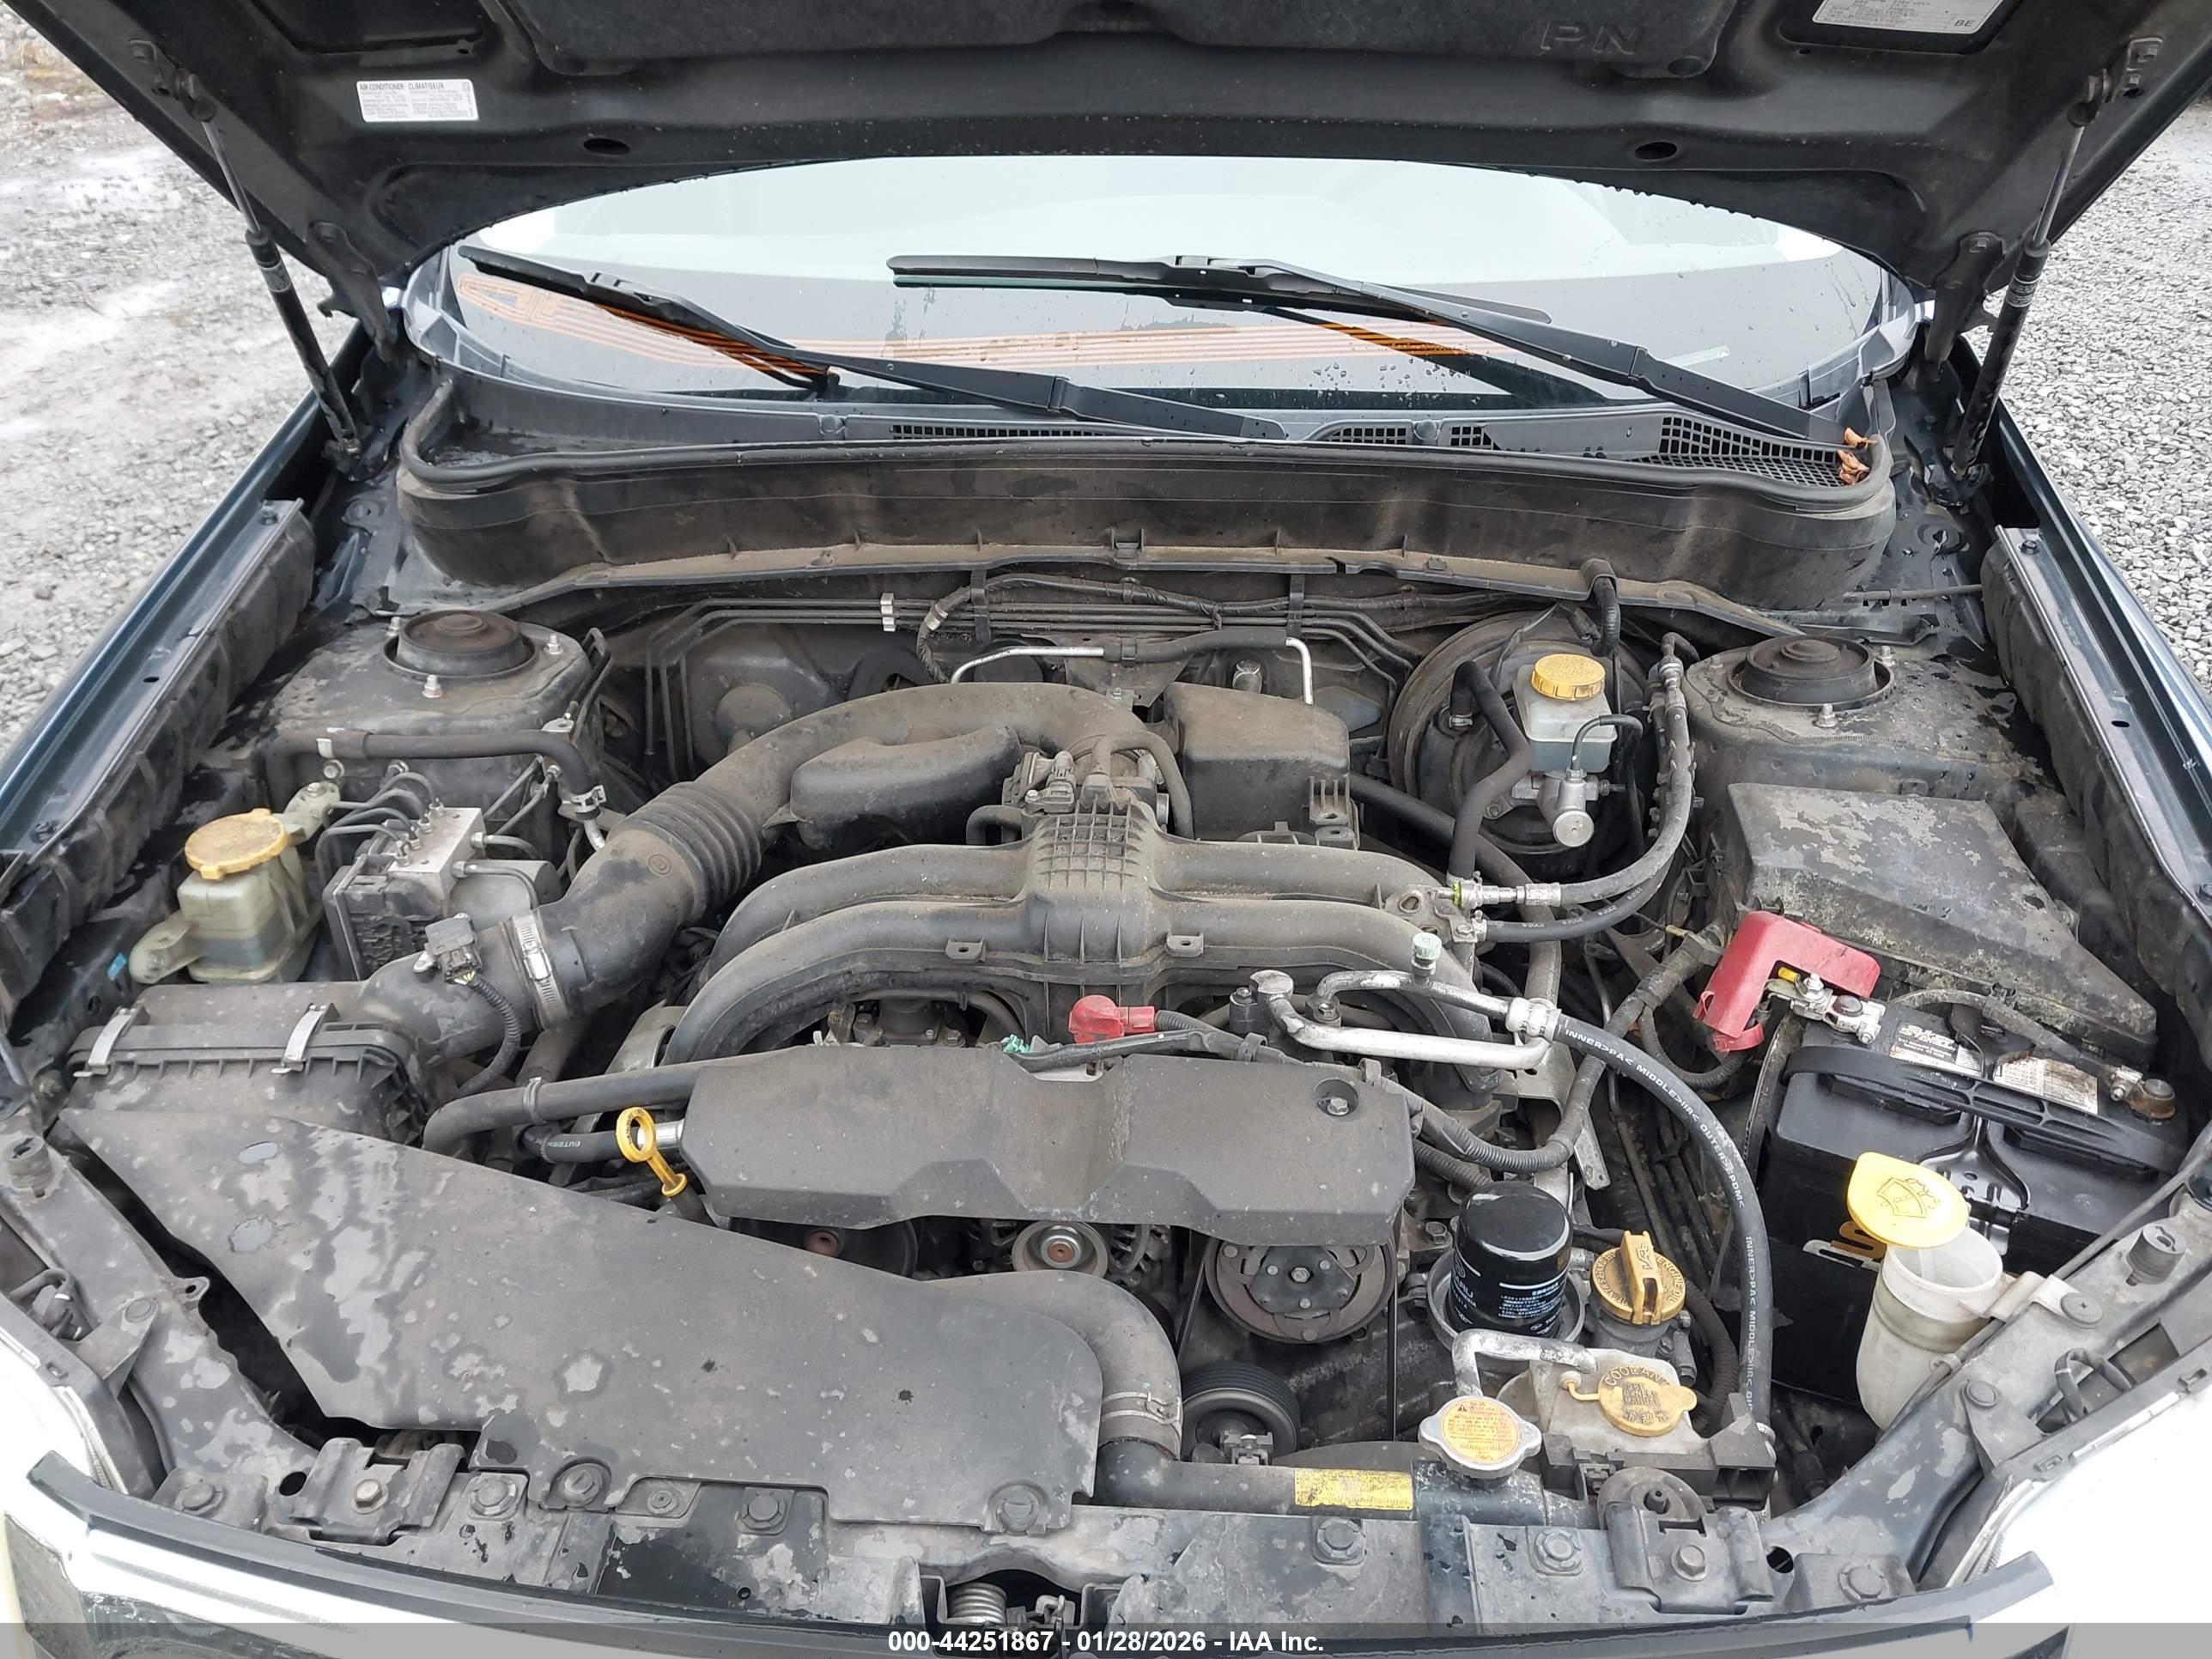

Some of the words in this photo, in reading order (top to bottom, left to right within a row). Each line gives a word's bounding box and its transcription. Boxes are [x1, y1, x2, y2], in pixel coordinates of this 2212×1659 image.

[369, 82, 404, 91] CONDITIONER
[1656, 1255, 1685, 1290] ENGINE
[1666, 1290, 1682, 1305] OIL
